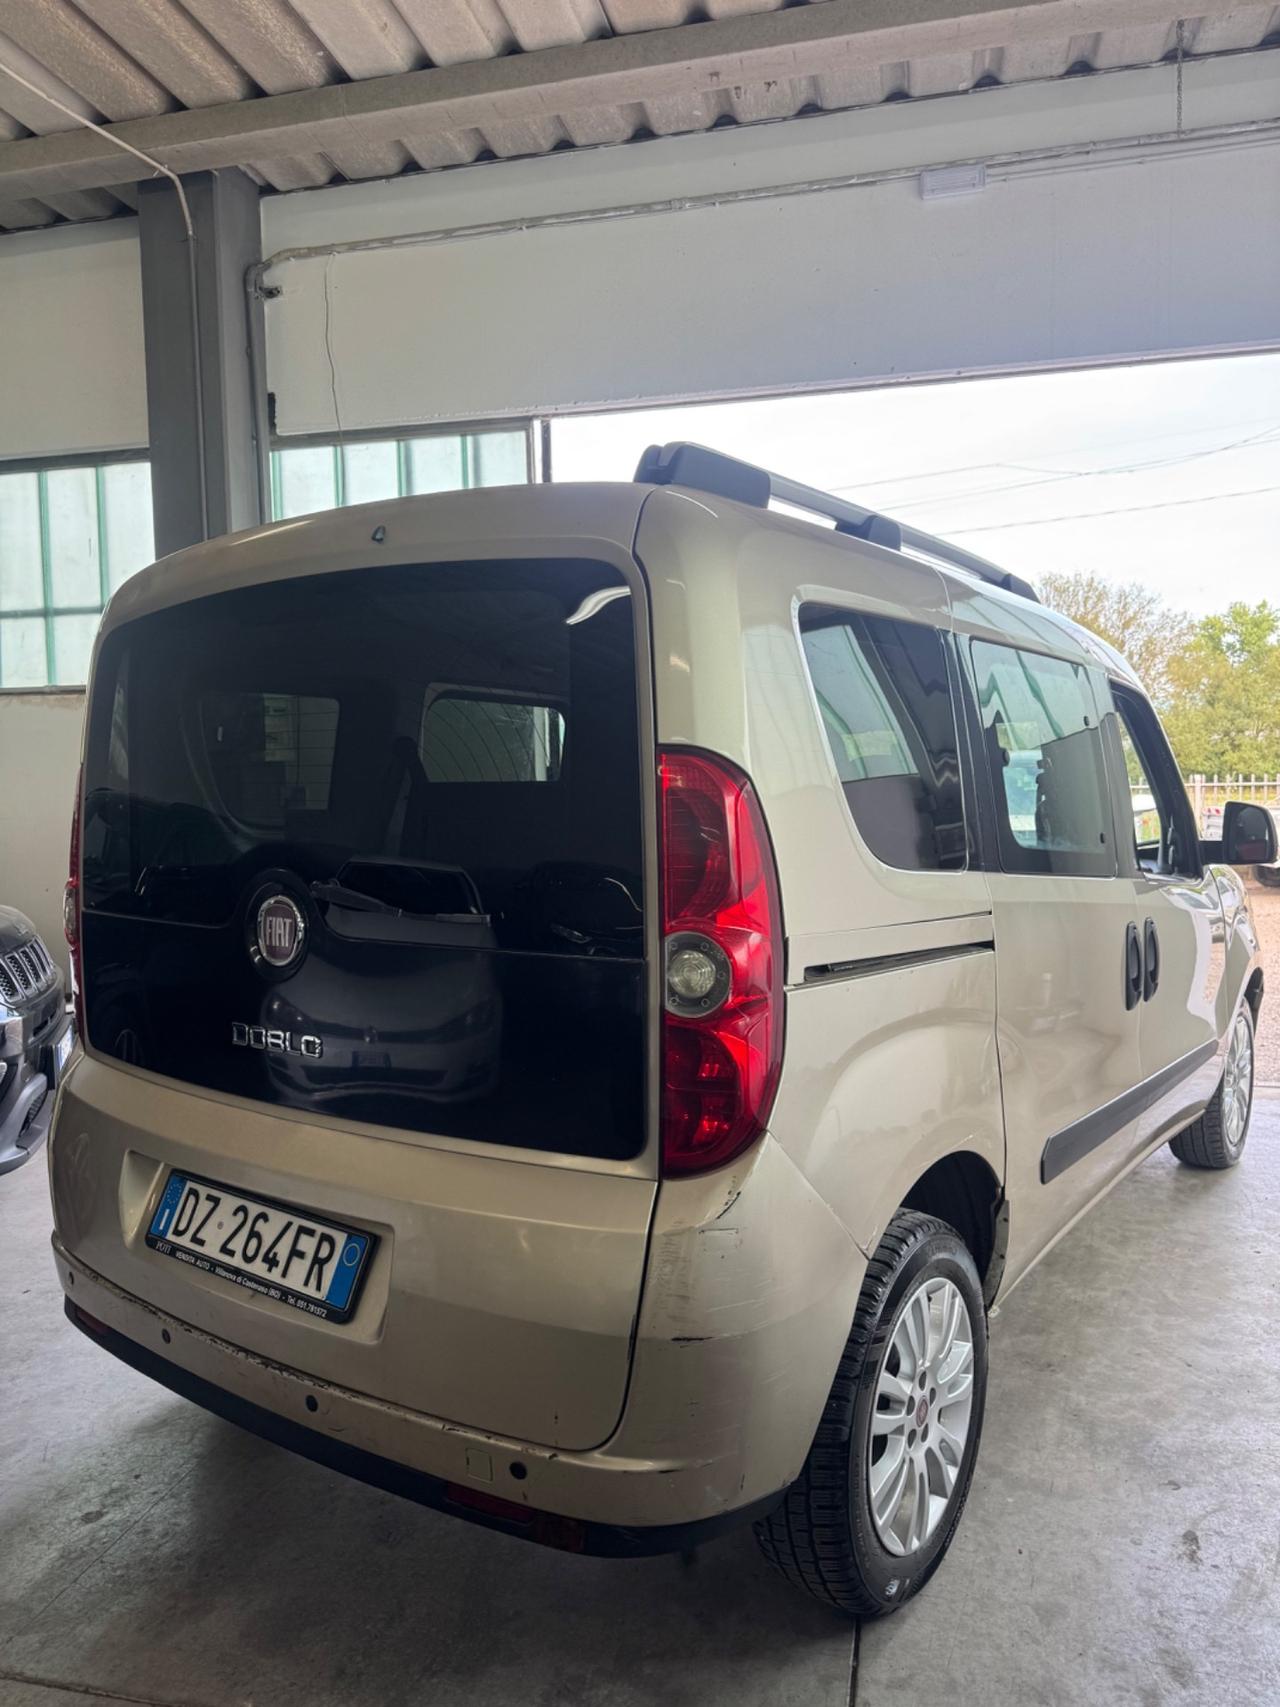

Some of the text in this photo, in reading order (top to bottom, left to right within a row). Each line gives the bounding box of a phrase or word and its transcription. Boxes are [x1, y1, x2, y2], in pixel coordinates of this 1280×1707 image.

[266, 916, 292, 948] FIAT
[159, 1209, 170, 1230] I
[172, 1187, 336, 1292] DZ 264FR
[196, 1260, 210, 1270] AUTO
